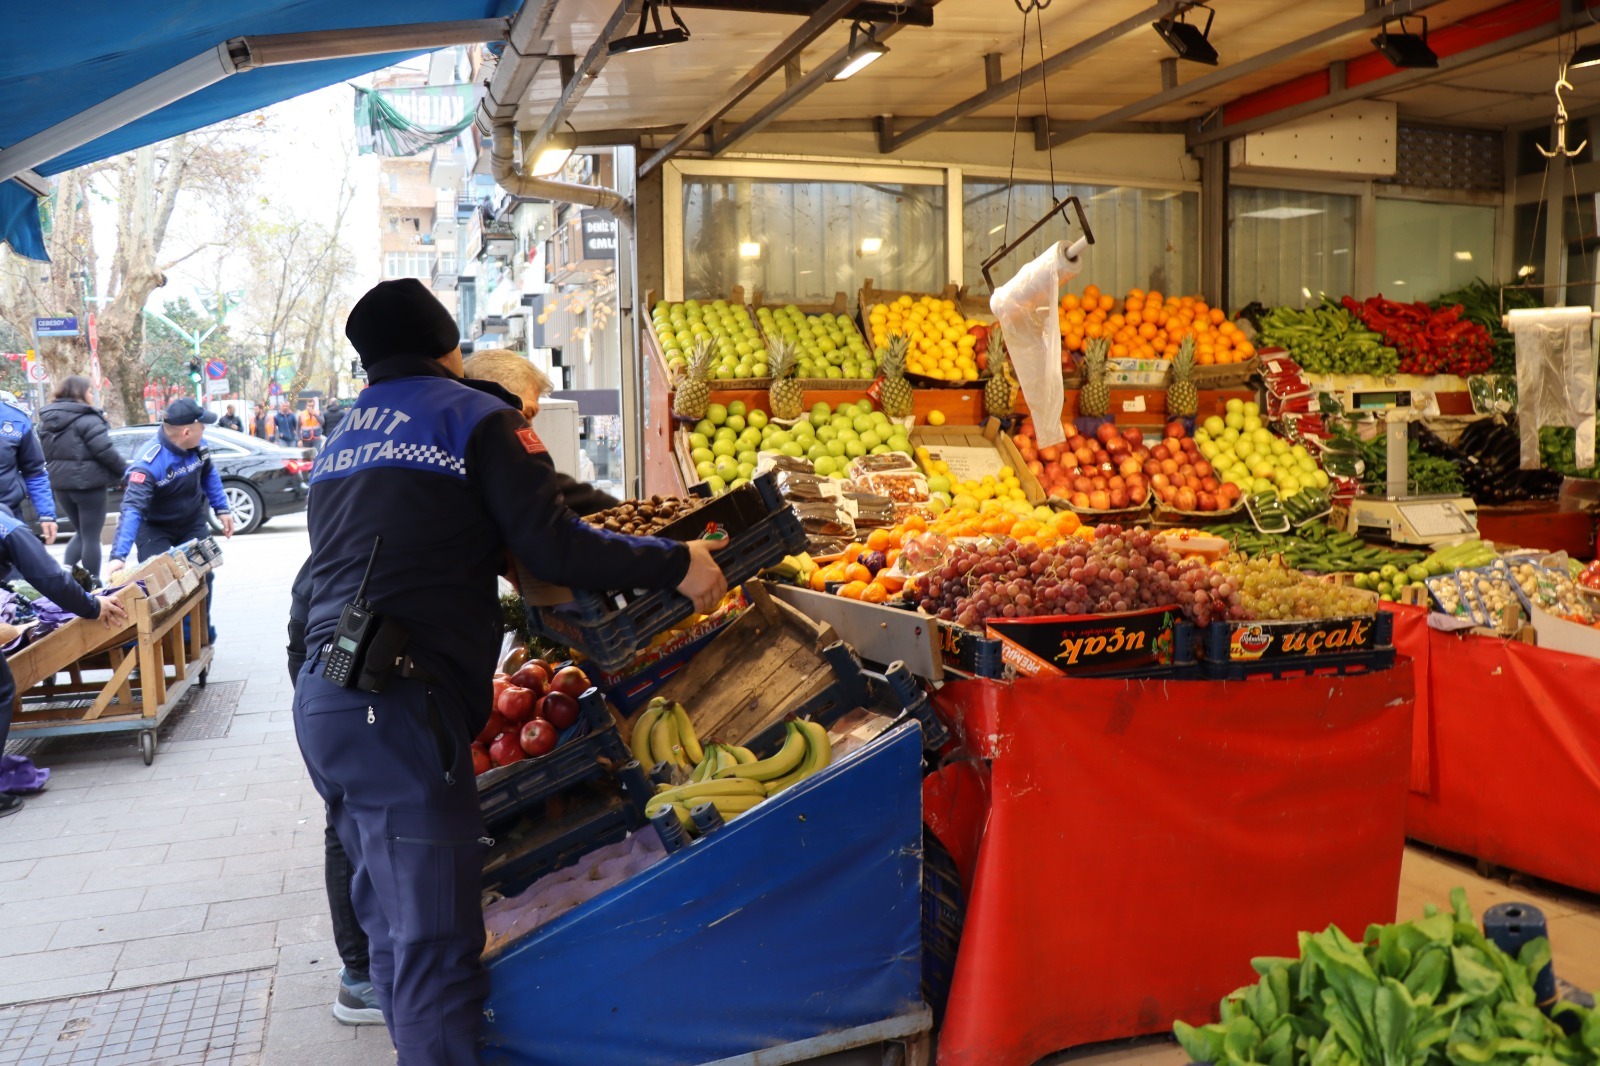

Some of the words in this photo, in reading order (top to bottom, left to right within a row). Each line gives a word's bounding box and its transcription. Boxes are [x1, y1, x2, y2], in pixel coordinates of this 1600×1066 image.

[312, 439, 395, 479] ZABITA
[1054, 626, 1146, 665] uçak
[1281, 619, 1371, 656] uçak
[1002, 641, 1041, 675] PREMIU
